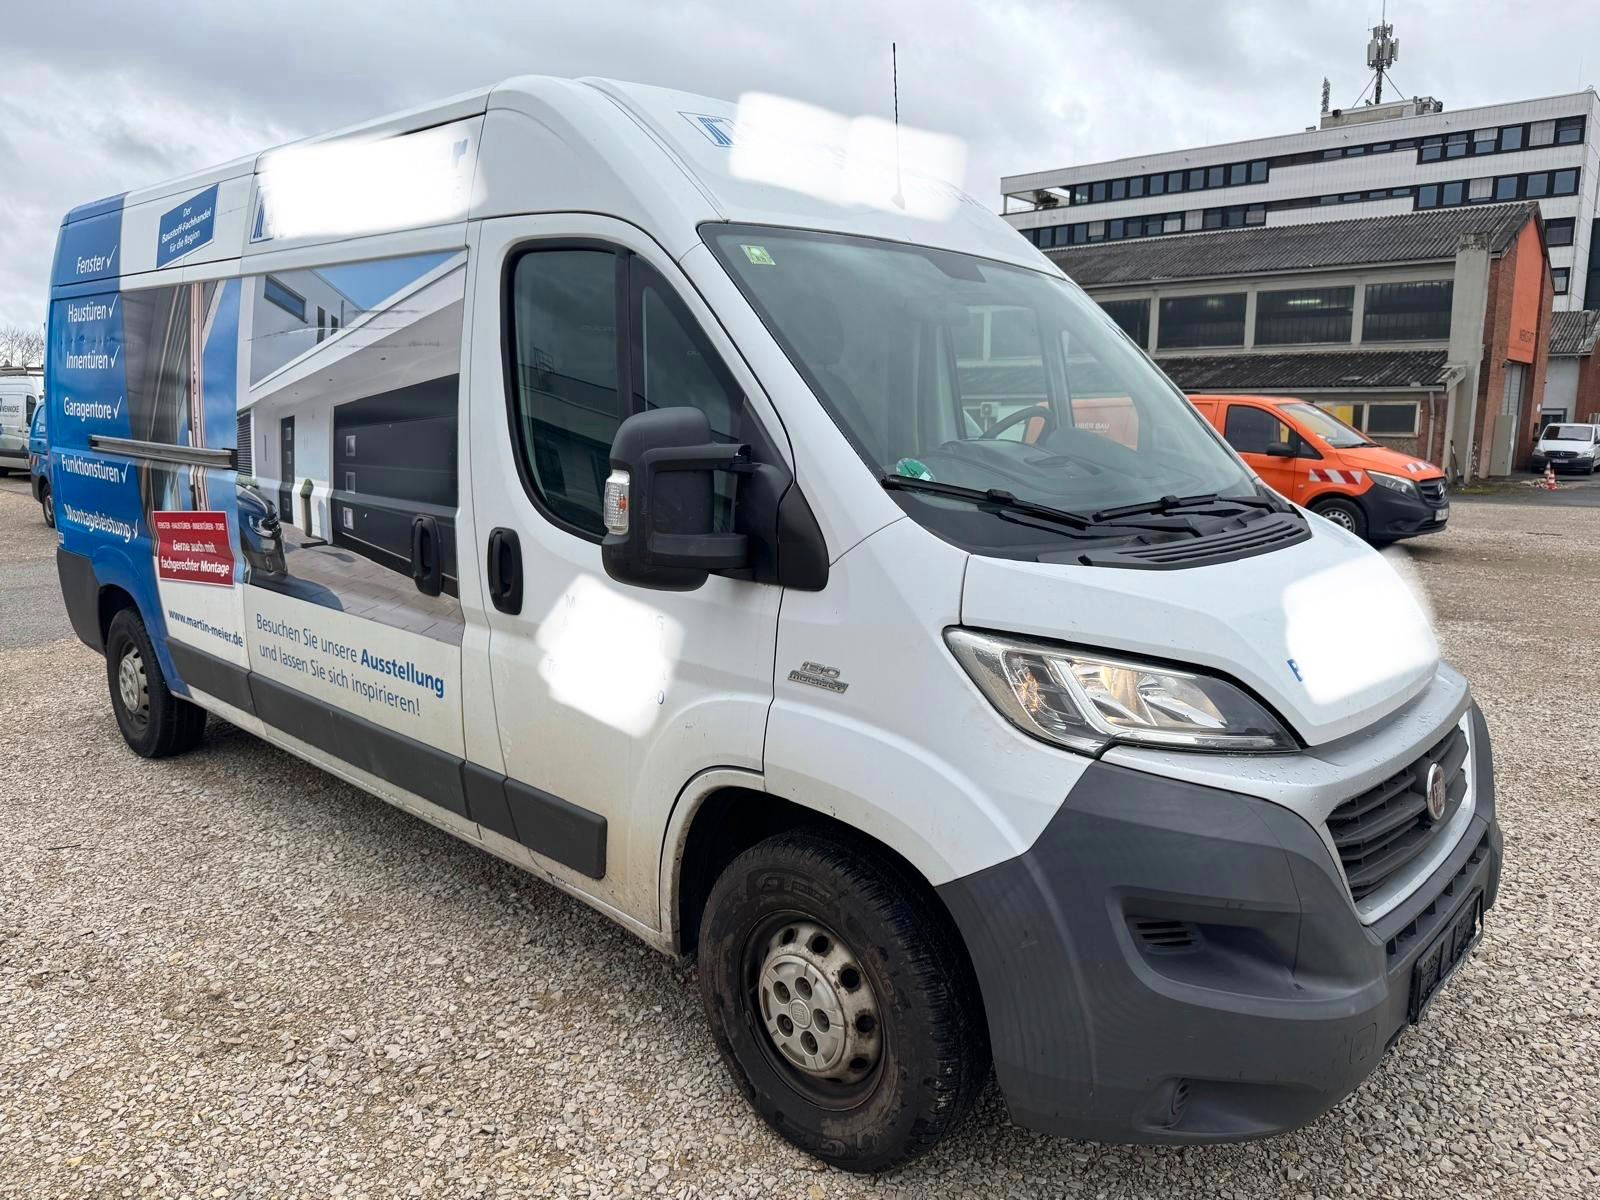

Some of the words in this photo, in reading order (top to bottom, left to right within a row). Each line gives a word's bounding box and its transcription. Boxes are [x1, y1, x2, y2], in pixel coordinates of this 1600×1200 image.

[183, 206, 193, 218] Der
[161, 207, 212, 245] Baustoff-Fachhandel
[169, 244, 178, 254] für
[184, 230, 201, 244] Region
[76, 255, 105, 275] Fenster
[68, 302, 107, 323] Haustüren
[66, 351, 108, 370] Innentüren
[64, 398, 112, 421] Garagentore
[61, 454, 120, 483] Funktionstüren
[64, 504, 131, 543] Montageleistung
[172, 540, 190, 551] Gerne
[191, 541, 205, 553] auch
[205, 542, 216, 553] mit
[161, 556, 199, 572] fachgerechter
[200, 560, 230, 576] Montage
[168, 609, 244, 648] www.martin-meier.de
[256, 613, 301, 643] Besuchen
[303, 628, 318, 649] Sie
[321, 635, 358, 663] unsere
[361, 648, 445, 699] Ausstellung
[259, 643, 278, 660] und
[280, 649, 308, 673] lassen
[310, 659, 327, 681] Sie
[328, 667, 349, 689] sich
[351, 673, 421, 717] inspirieren!
